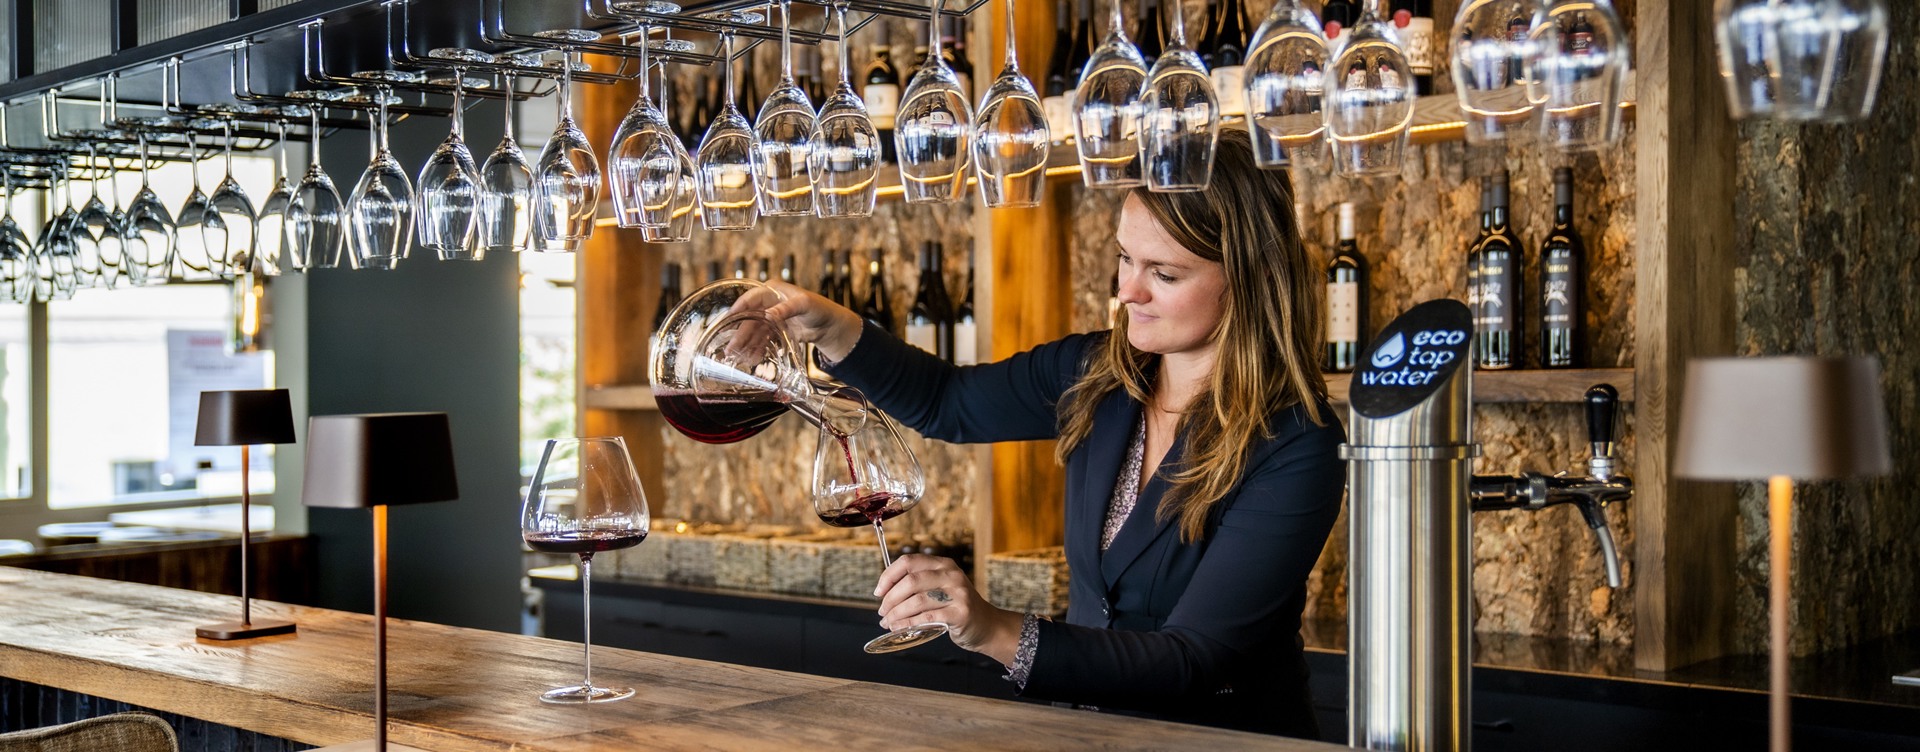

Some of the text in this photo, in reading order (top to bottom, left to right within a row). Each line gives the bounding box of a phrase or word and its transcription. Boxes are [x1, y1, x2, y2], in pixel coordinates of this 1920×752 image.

[1412, 330, 1466, 346] eco
[1408, 346, 1455, 369] tap
[1361, 366, 1439, 386] water
